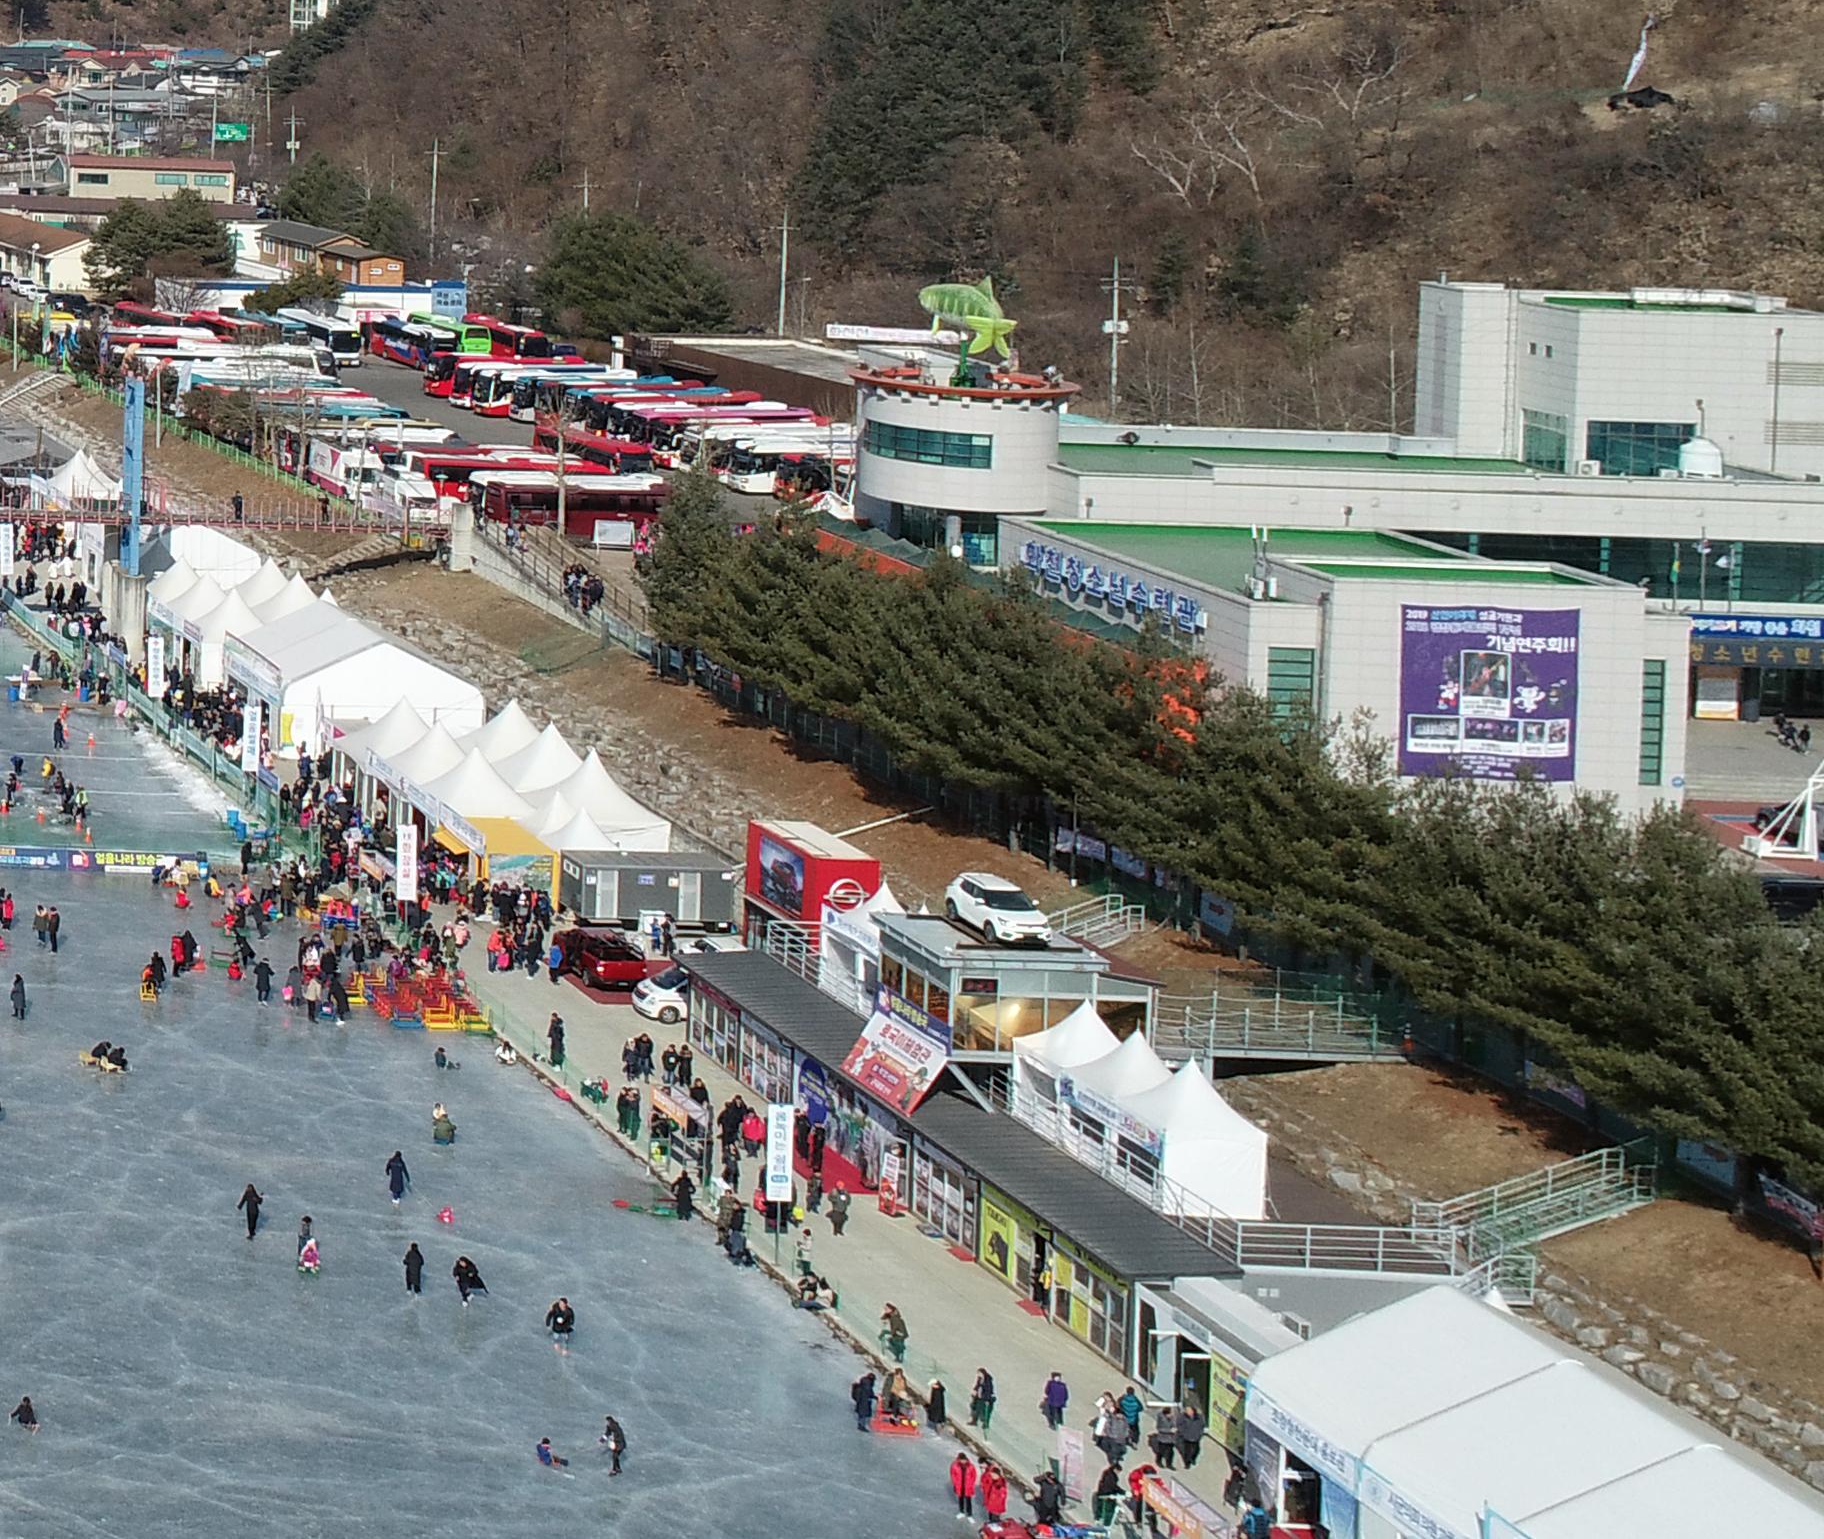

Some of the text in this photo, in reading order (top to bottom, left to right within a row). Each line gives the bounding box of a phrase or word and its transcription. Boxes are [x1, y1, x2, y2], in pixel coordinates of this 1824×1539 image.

[1024, 539, 1200, 633] 화천청소년수련관
[1486, 635, 1576, 653] 기념연주회!!
[1690, 643, 1824, 665] 청소년수련
